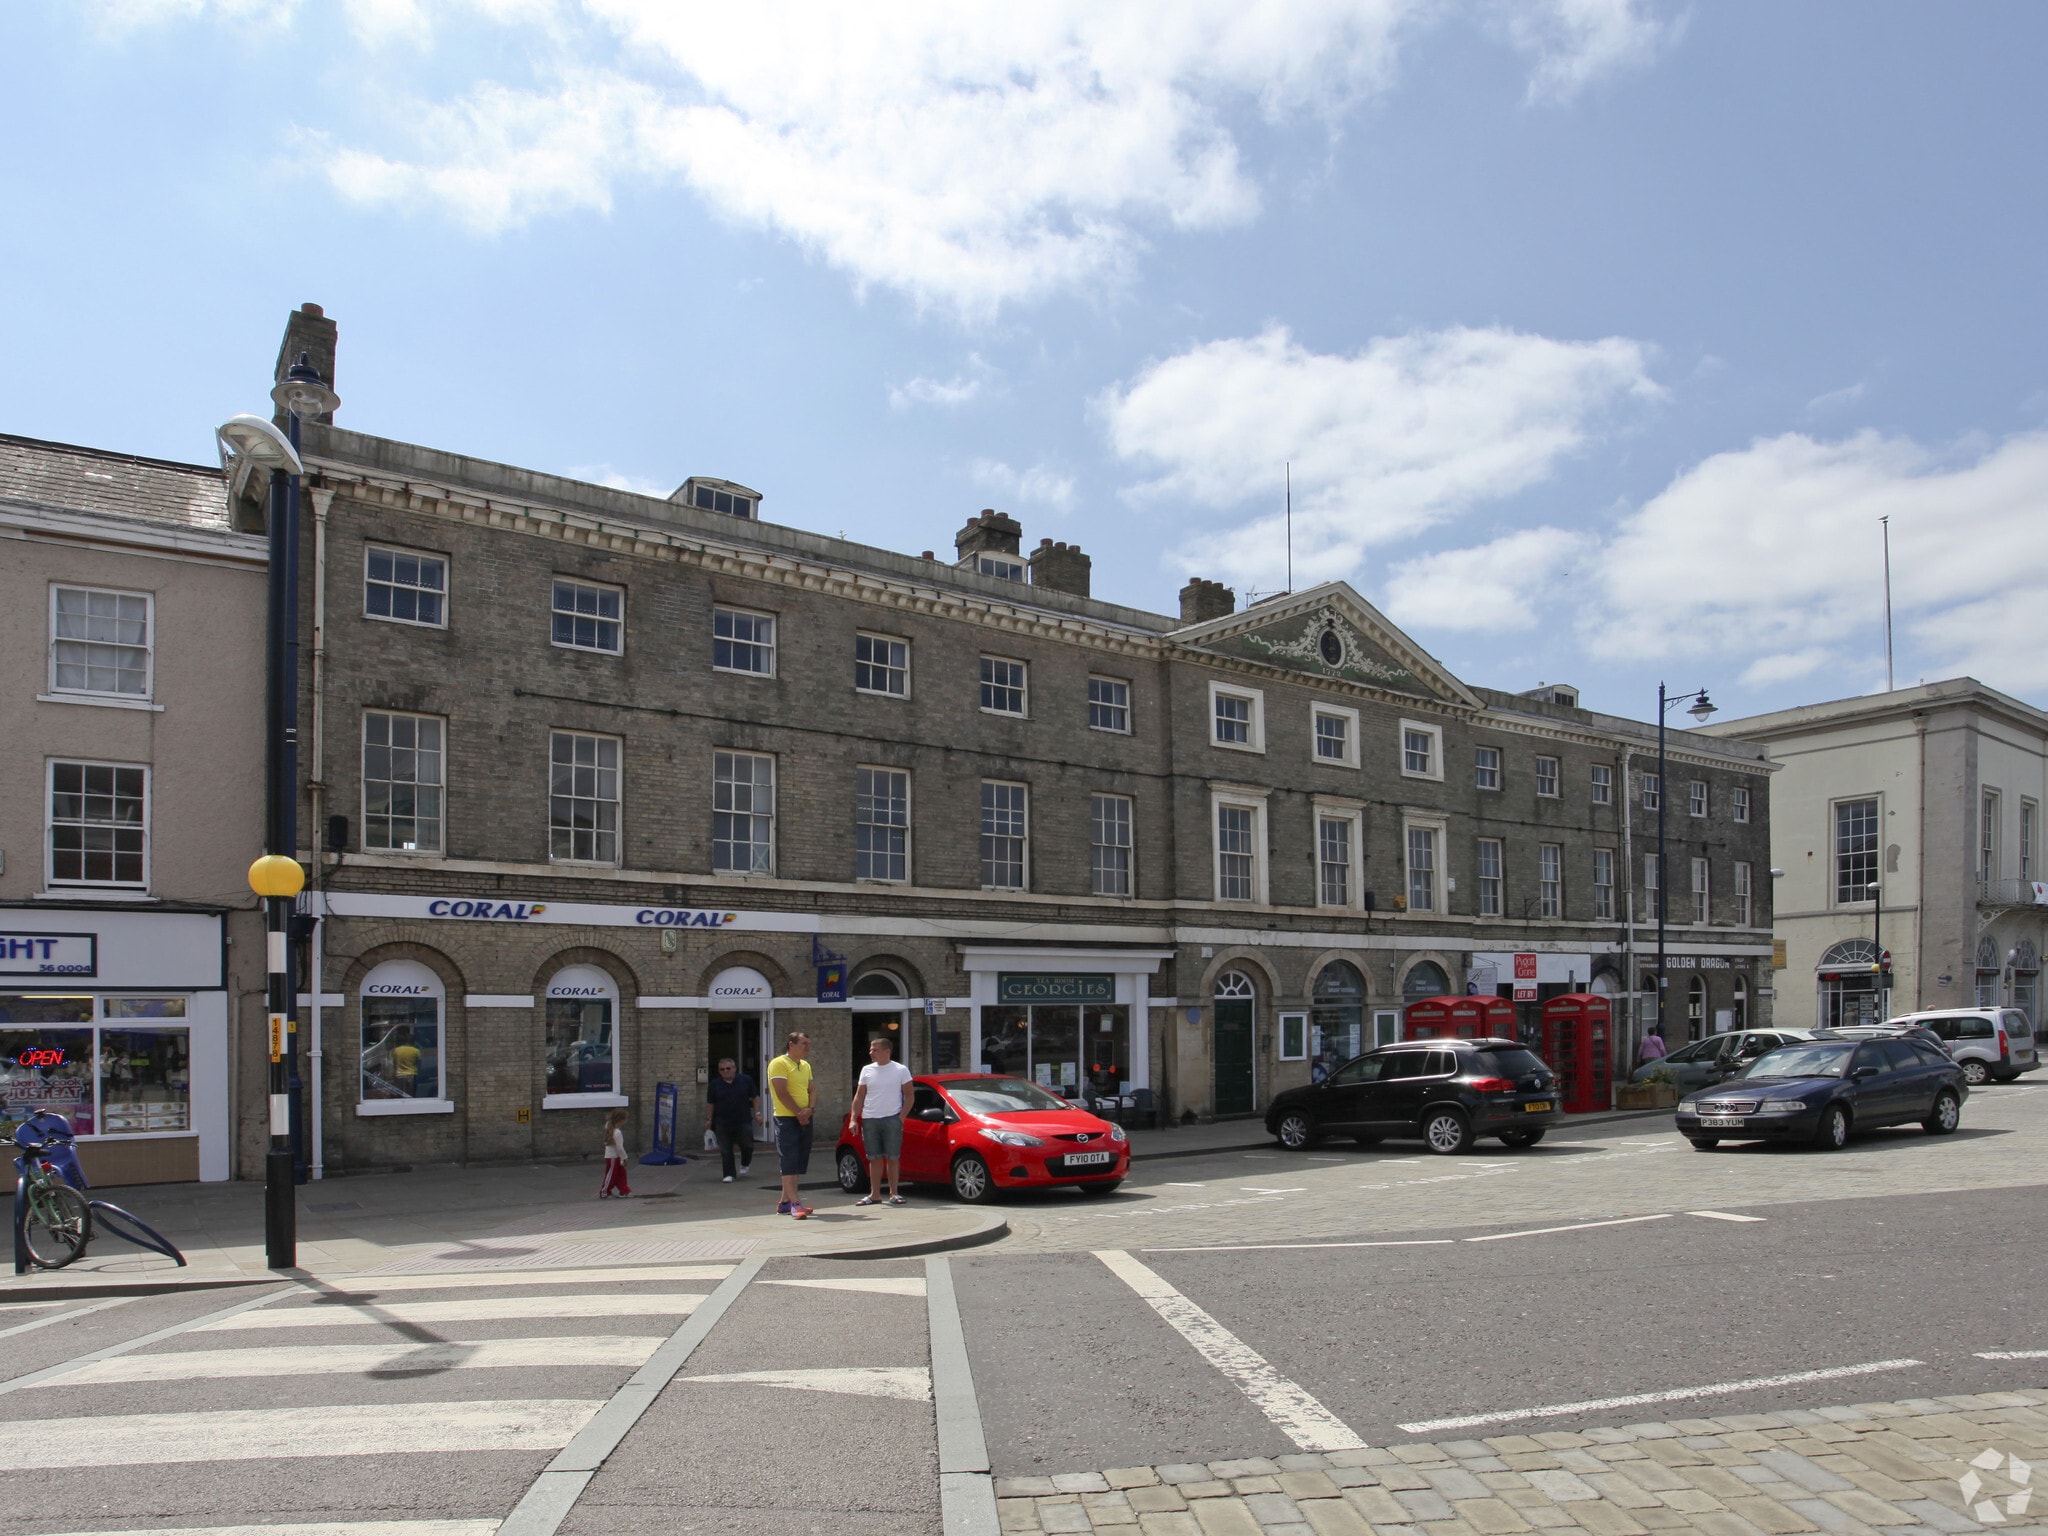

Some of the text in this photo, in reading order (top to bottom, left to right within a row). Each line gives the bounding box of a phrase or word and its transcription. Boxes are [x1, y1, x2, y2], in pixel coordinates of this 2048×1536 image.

[429, 900, 530, 919] CORAL
[636, 910, 723, 928] CORAL
[1666, 957, 1696, 968] GOLDEN
[369, 984, 422, 994] CORAL
[551, 987, 598, 996] CORAL
[715, 987, 757, 996] CORAL
[1008, 980, 1106, 996] GEORGIES
[822, 991, 841, 999] CORAL
[1517, 990, 1534, 998] LET BY
[19, 1050, 63, 1066] OPEN
[53, 1079, 81, 1087] cook
[7, 1087, 82, 1100] JUST EAT
[1070, 1153, 1105, 1164] FY10 OTA
